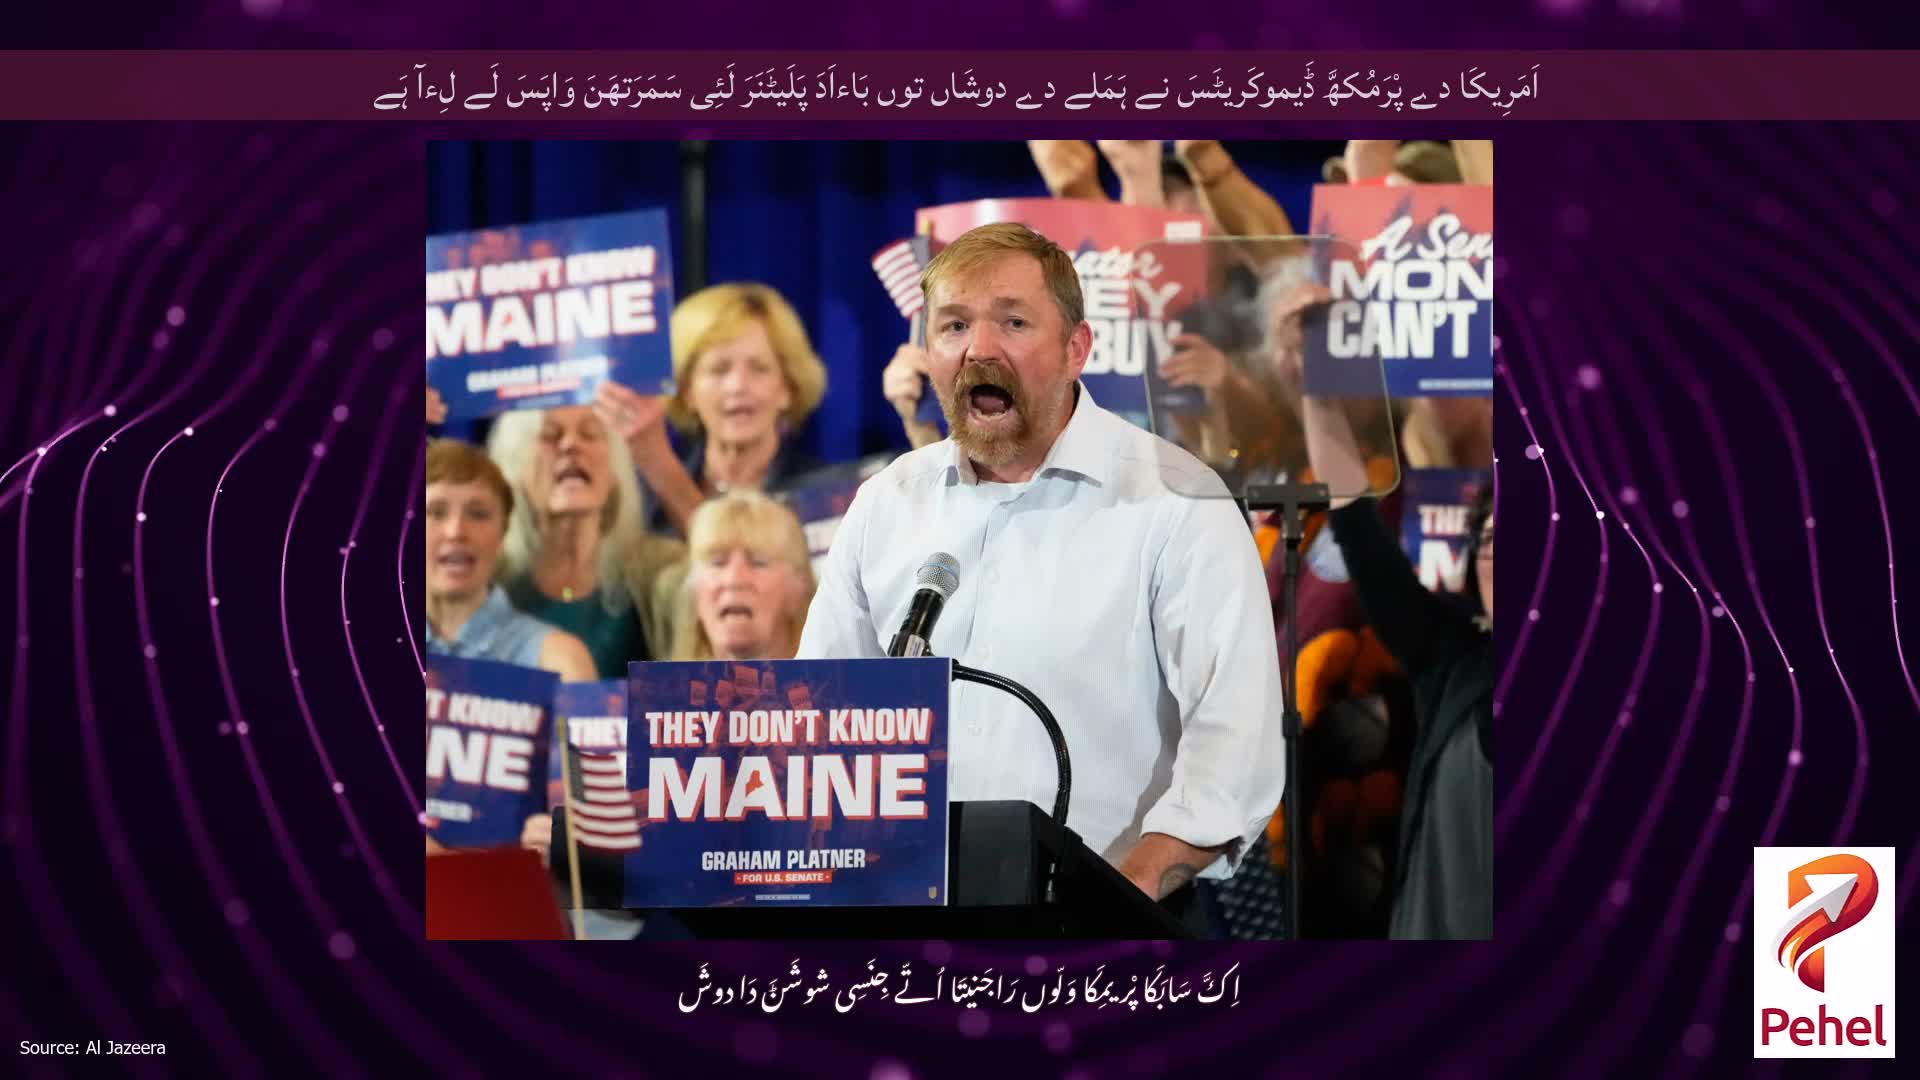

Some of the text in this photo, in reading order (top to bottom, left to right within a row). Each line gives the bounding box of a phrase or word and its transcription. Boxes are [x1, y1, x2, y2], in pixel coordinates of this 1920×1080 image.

[1330, 259, 1494, 301] MON
[426, 280, 657, 359] MAINE
[1327, 300, 1478, 359] CAN'T
[1417, 504, 1468, 536] THE
[645, 707, 933, 747] THEY DON'T KNOW
[647, 753, 929, 820] MAINE
[701, 848, 866, 871] GRAHAM PLATNER
[743, 872, 824, 882] FOR U.S. SENATE
